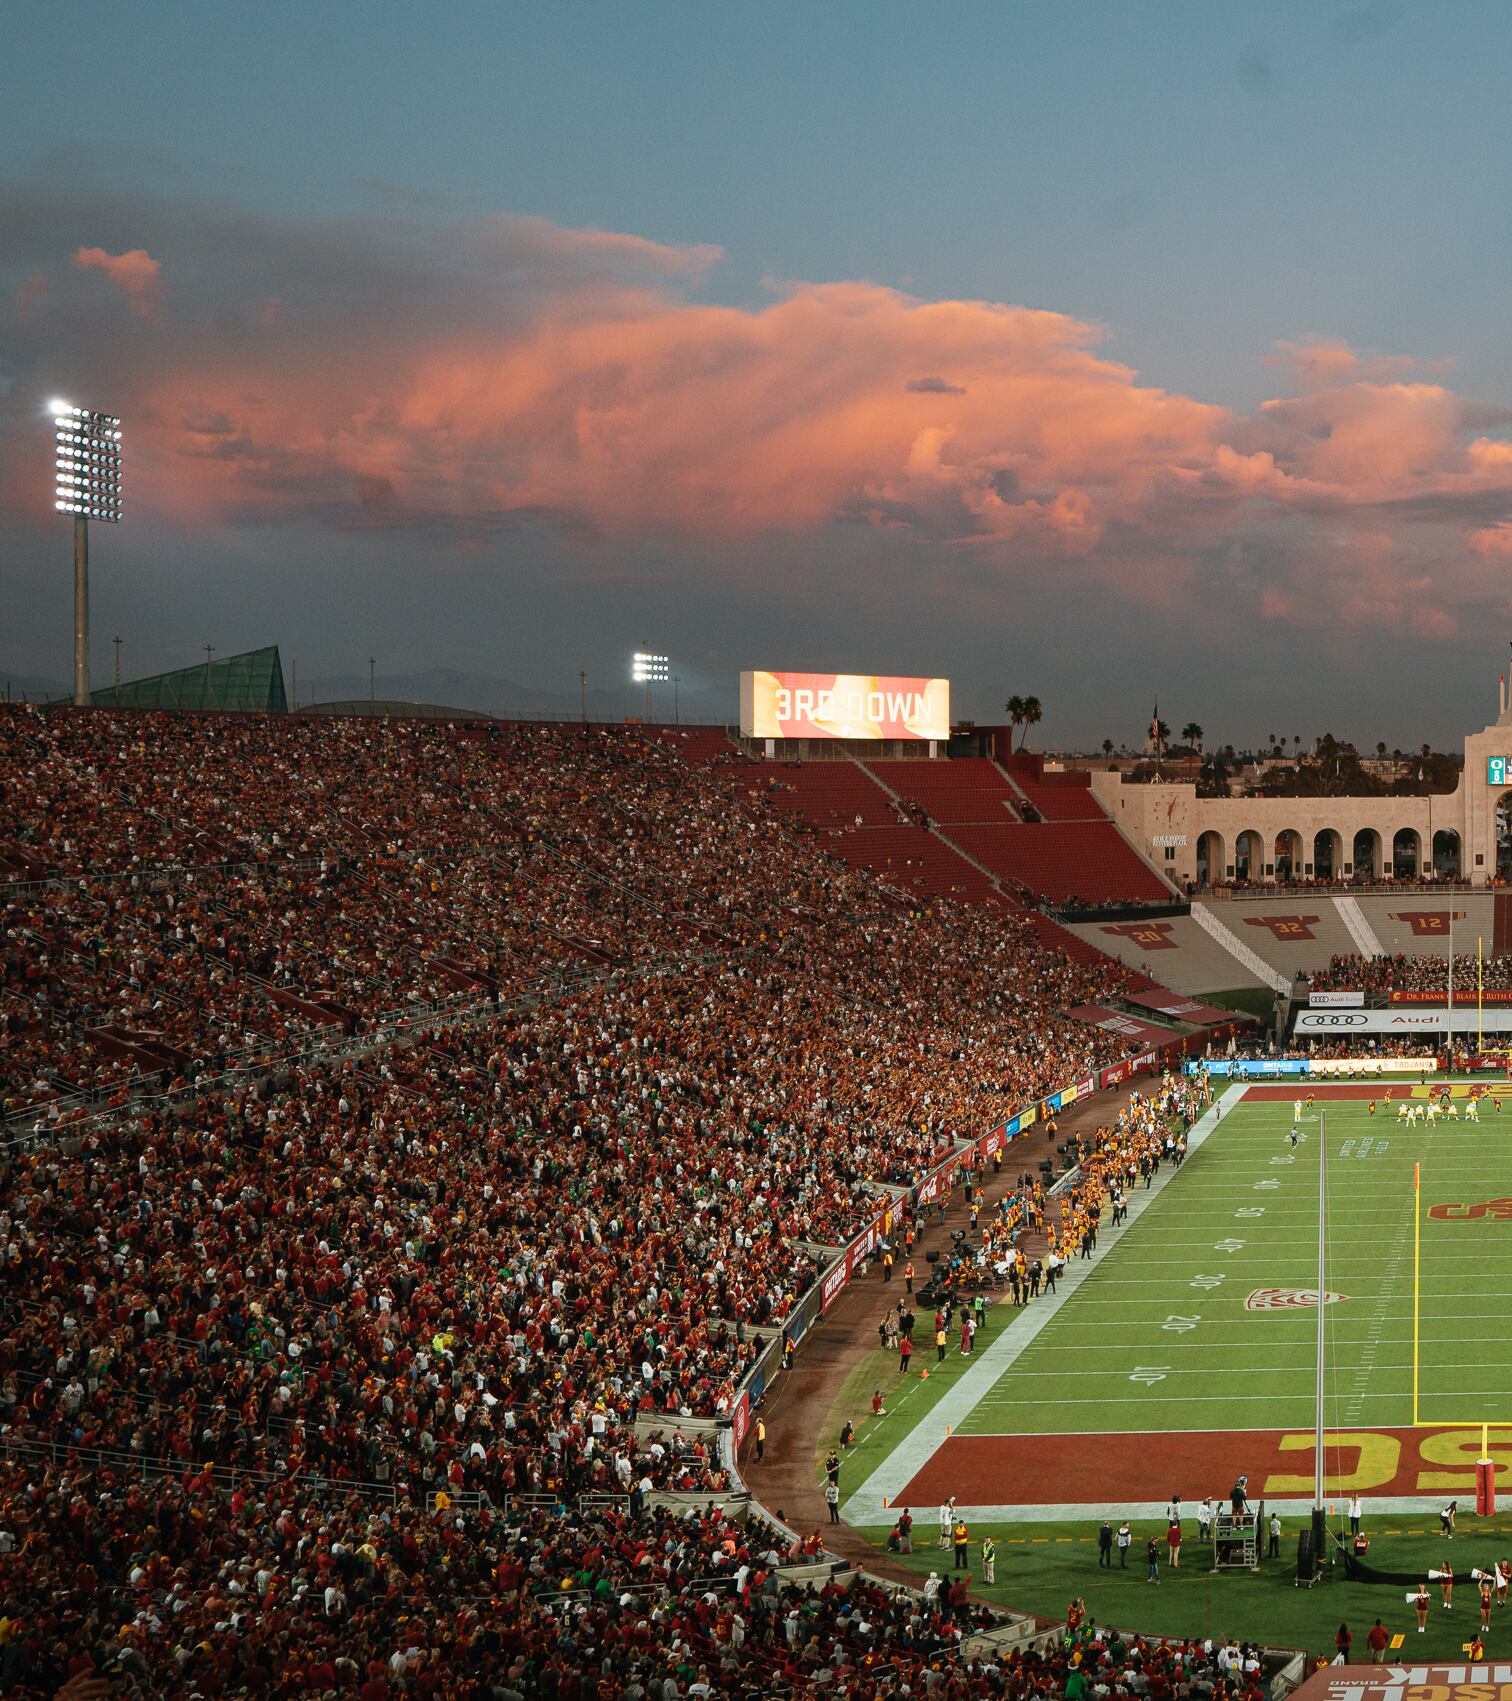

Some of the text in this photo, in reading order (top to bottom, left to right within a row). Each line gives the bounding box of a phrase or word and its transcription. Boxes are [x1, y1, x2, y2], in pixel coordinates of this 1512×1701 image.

[775, 689, 932, 723] 3RD DOWN
[1275, 922, 1303, 933] 32
[1418, 918, 1442, 928] 12
[1132, 930, 1163, 943] 20
[1391, 1016, 1440, 1024] Audi
[1394, 1061, 1430, 1069] TROJANS
[1234, 1207, 1265, 1218] 50
[1214, 1238, 1247, 1251] 40
[1190, 1273, 1226, 1288] 30
[1162, 1315, 1201, 1331] 20
[1129, 1365, 1172, 1382] 10
[564, 1615, 570, 1626] 6
